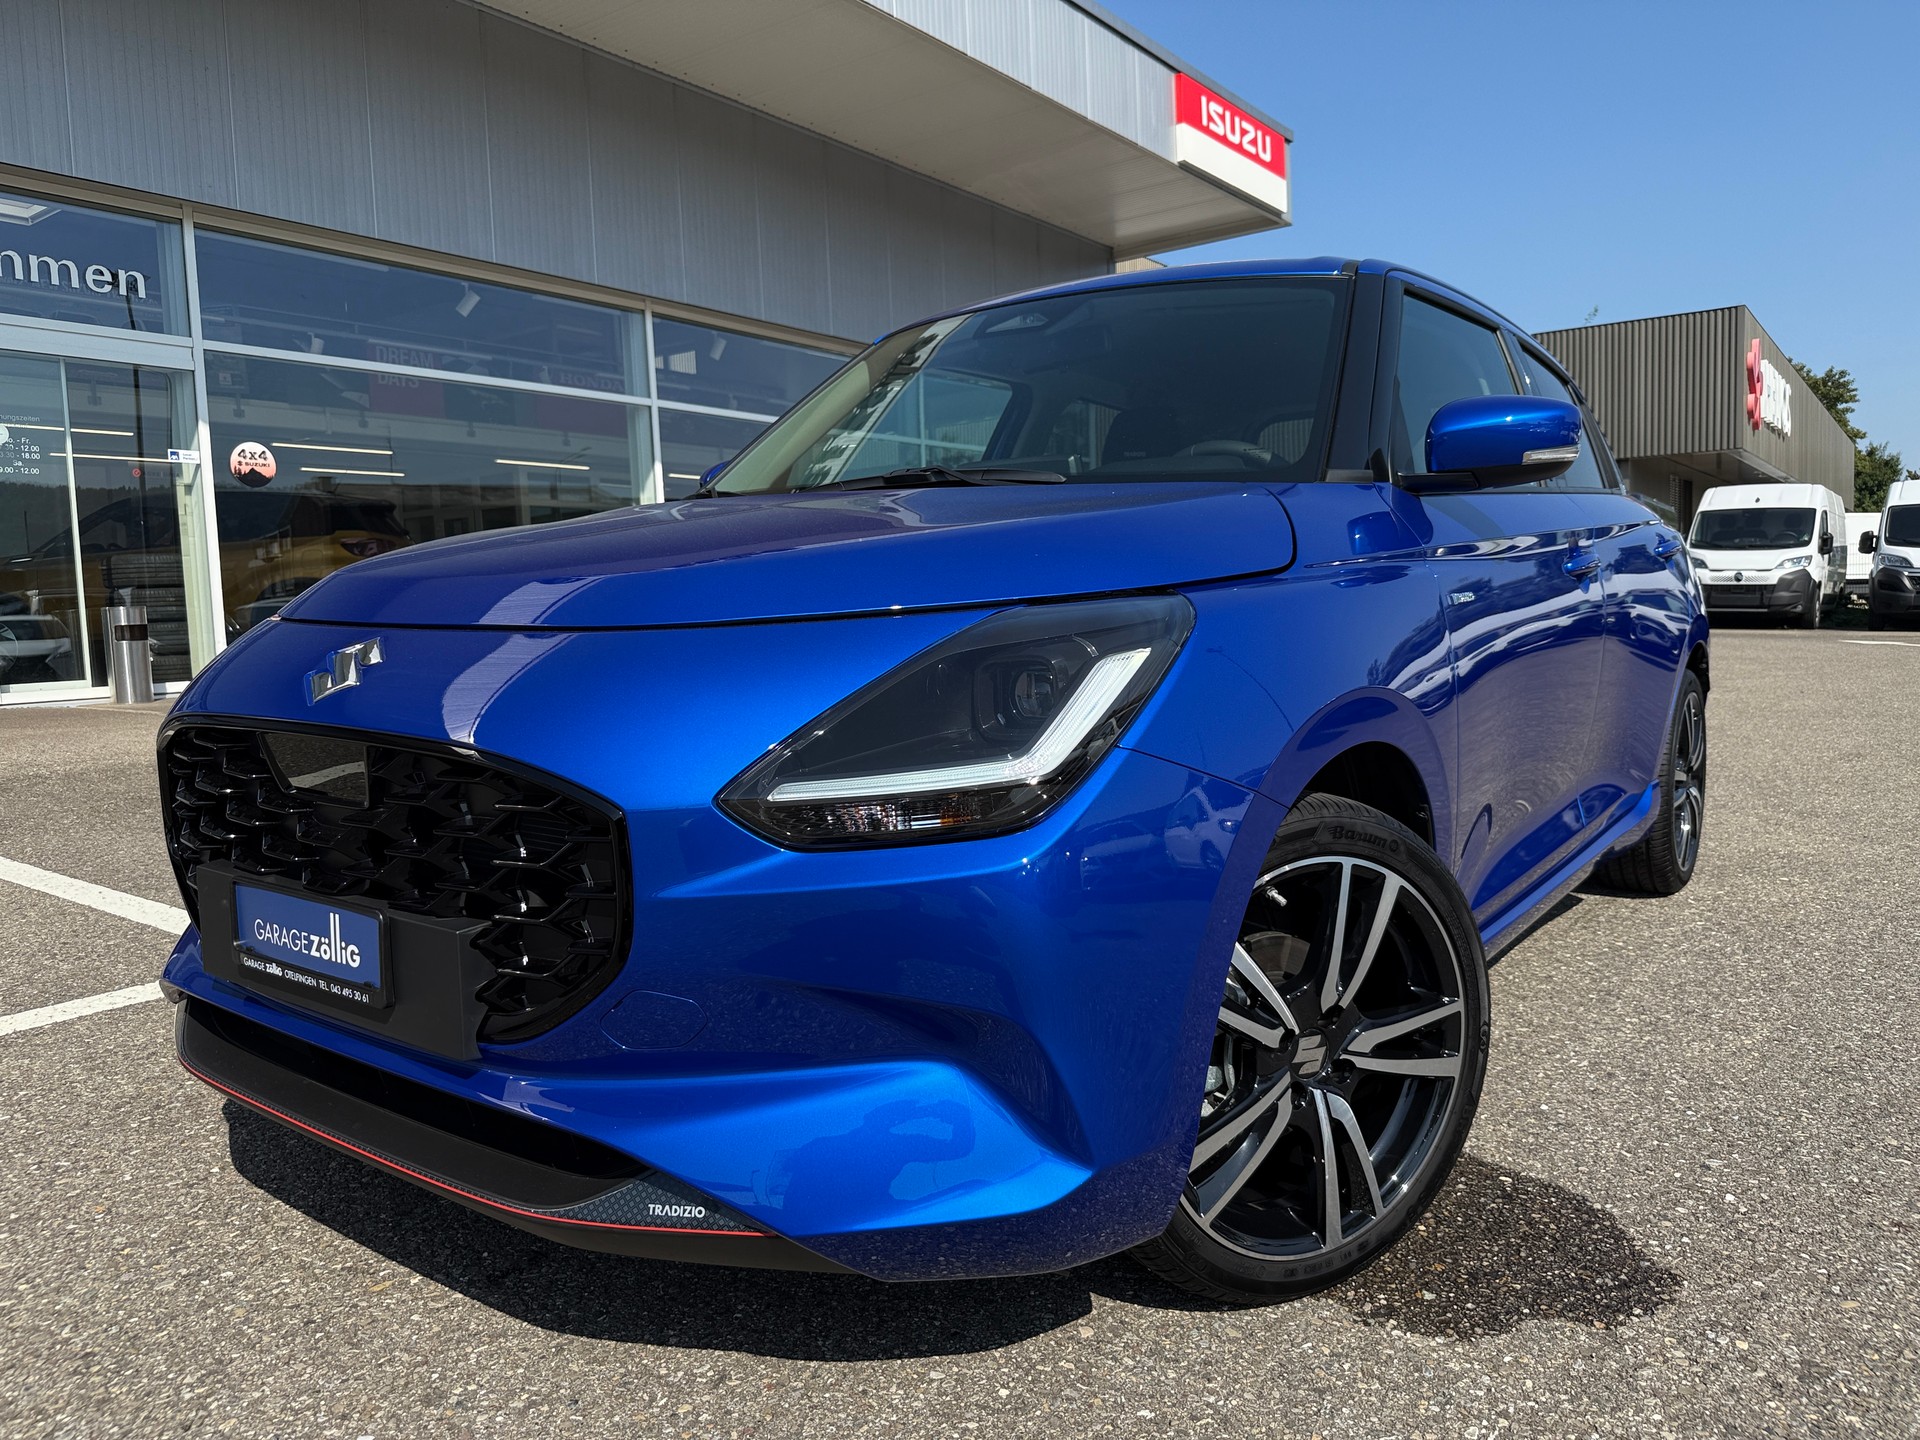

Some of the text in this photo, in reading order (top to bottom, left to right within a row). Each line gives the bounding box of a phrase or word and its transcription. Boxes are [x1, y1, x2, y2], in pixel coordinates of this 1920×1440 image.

[1201, 95, 1271, 162] ISUZU
[375, 346, 434, 368] DREAM
[243, 957, 266, 971] GARAGE
[330, 984, 342, 995] 043
[341, 988, 353, 998] 495
[353, 991, 362, 1001] 30
[361, 993, 370, 1004] 61
[648, 1204, 706, 1218] TRADIZIO
